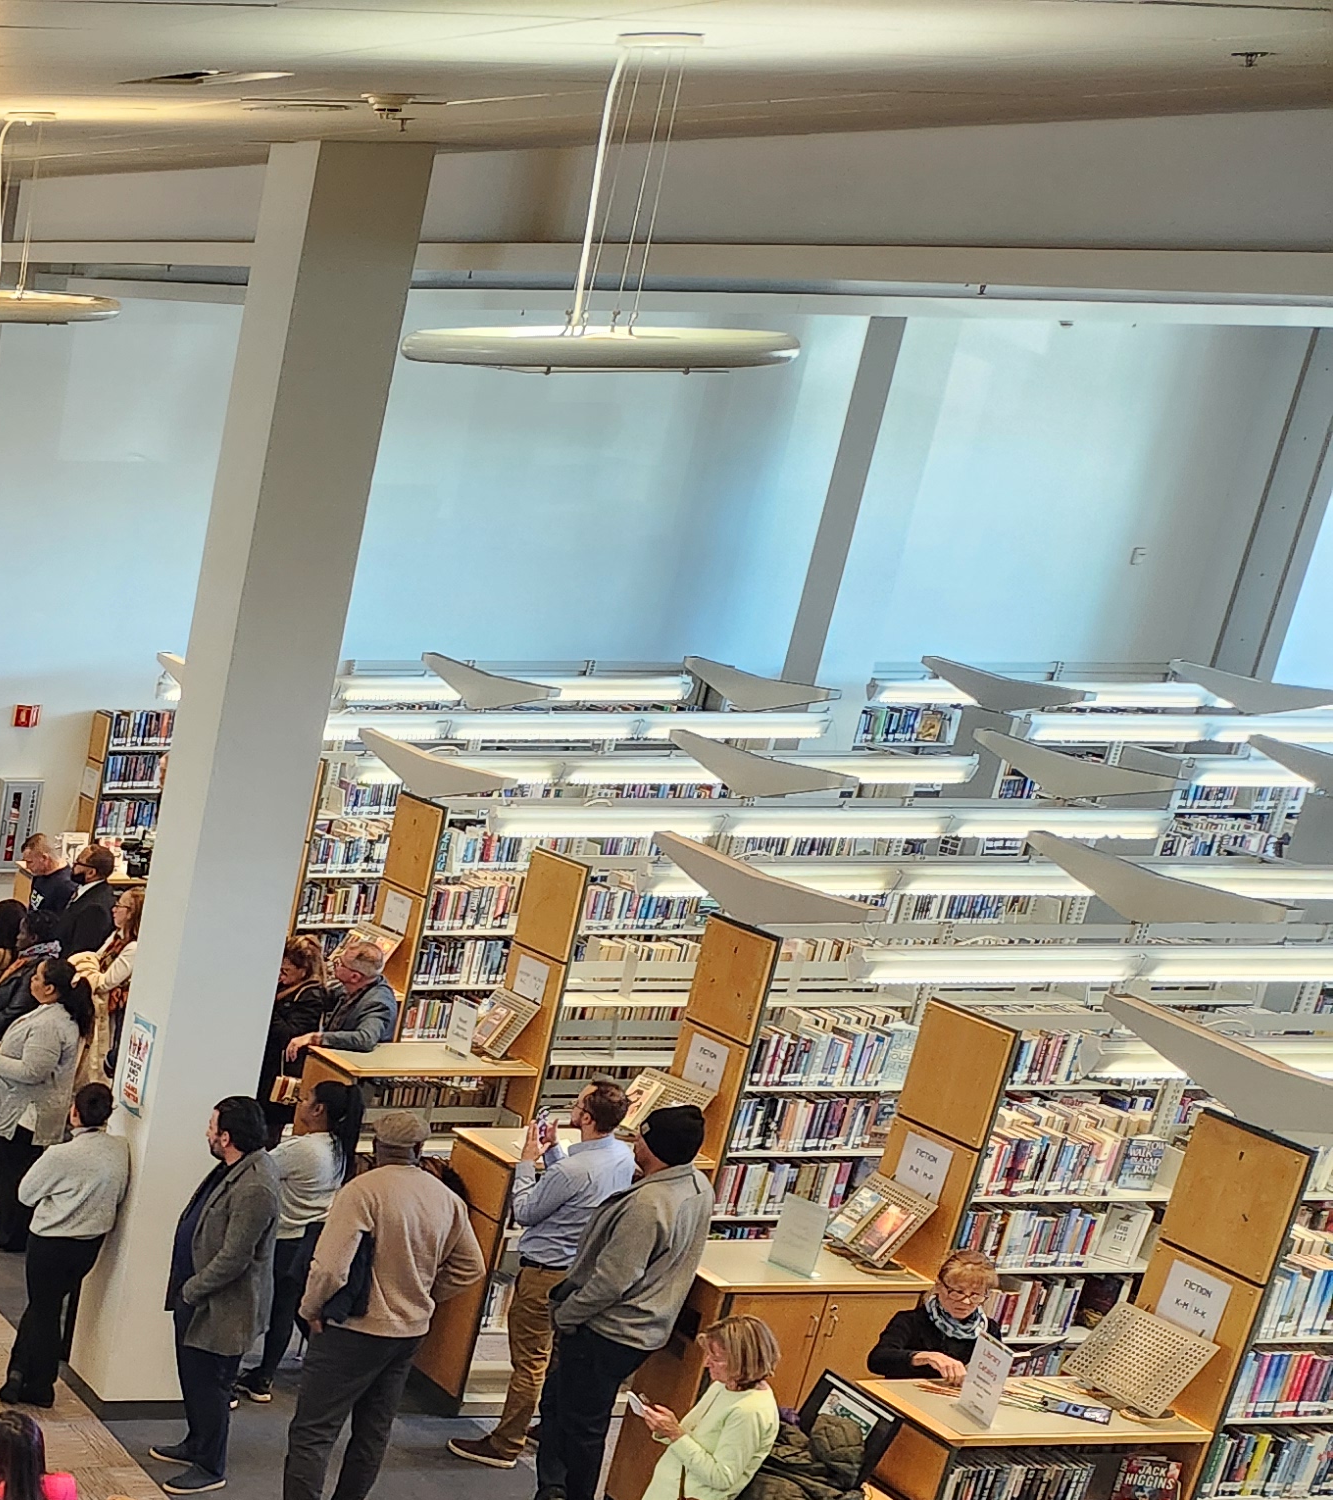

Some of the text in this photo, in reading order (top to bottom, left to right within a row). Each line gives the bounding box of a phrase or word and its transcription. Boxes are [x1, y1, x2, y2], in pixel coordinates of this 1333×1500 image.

[916, 1148, 938, 1163] FICTION
[1184, 1279, 1213, 1298] FICTION
[1138, 1465, 1167, 1477] JACK
[1124, 1473, 1175, 1490] HIGGINS
